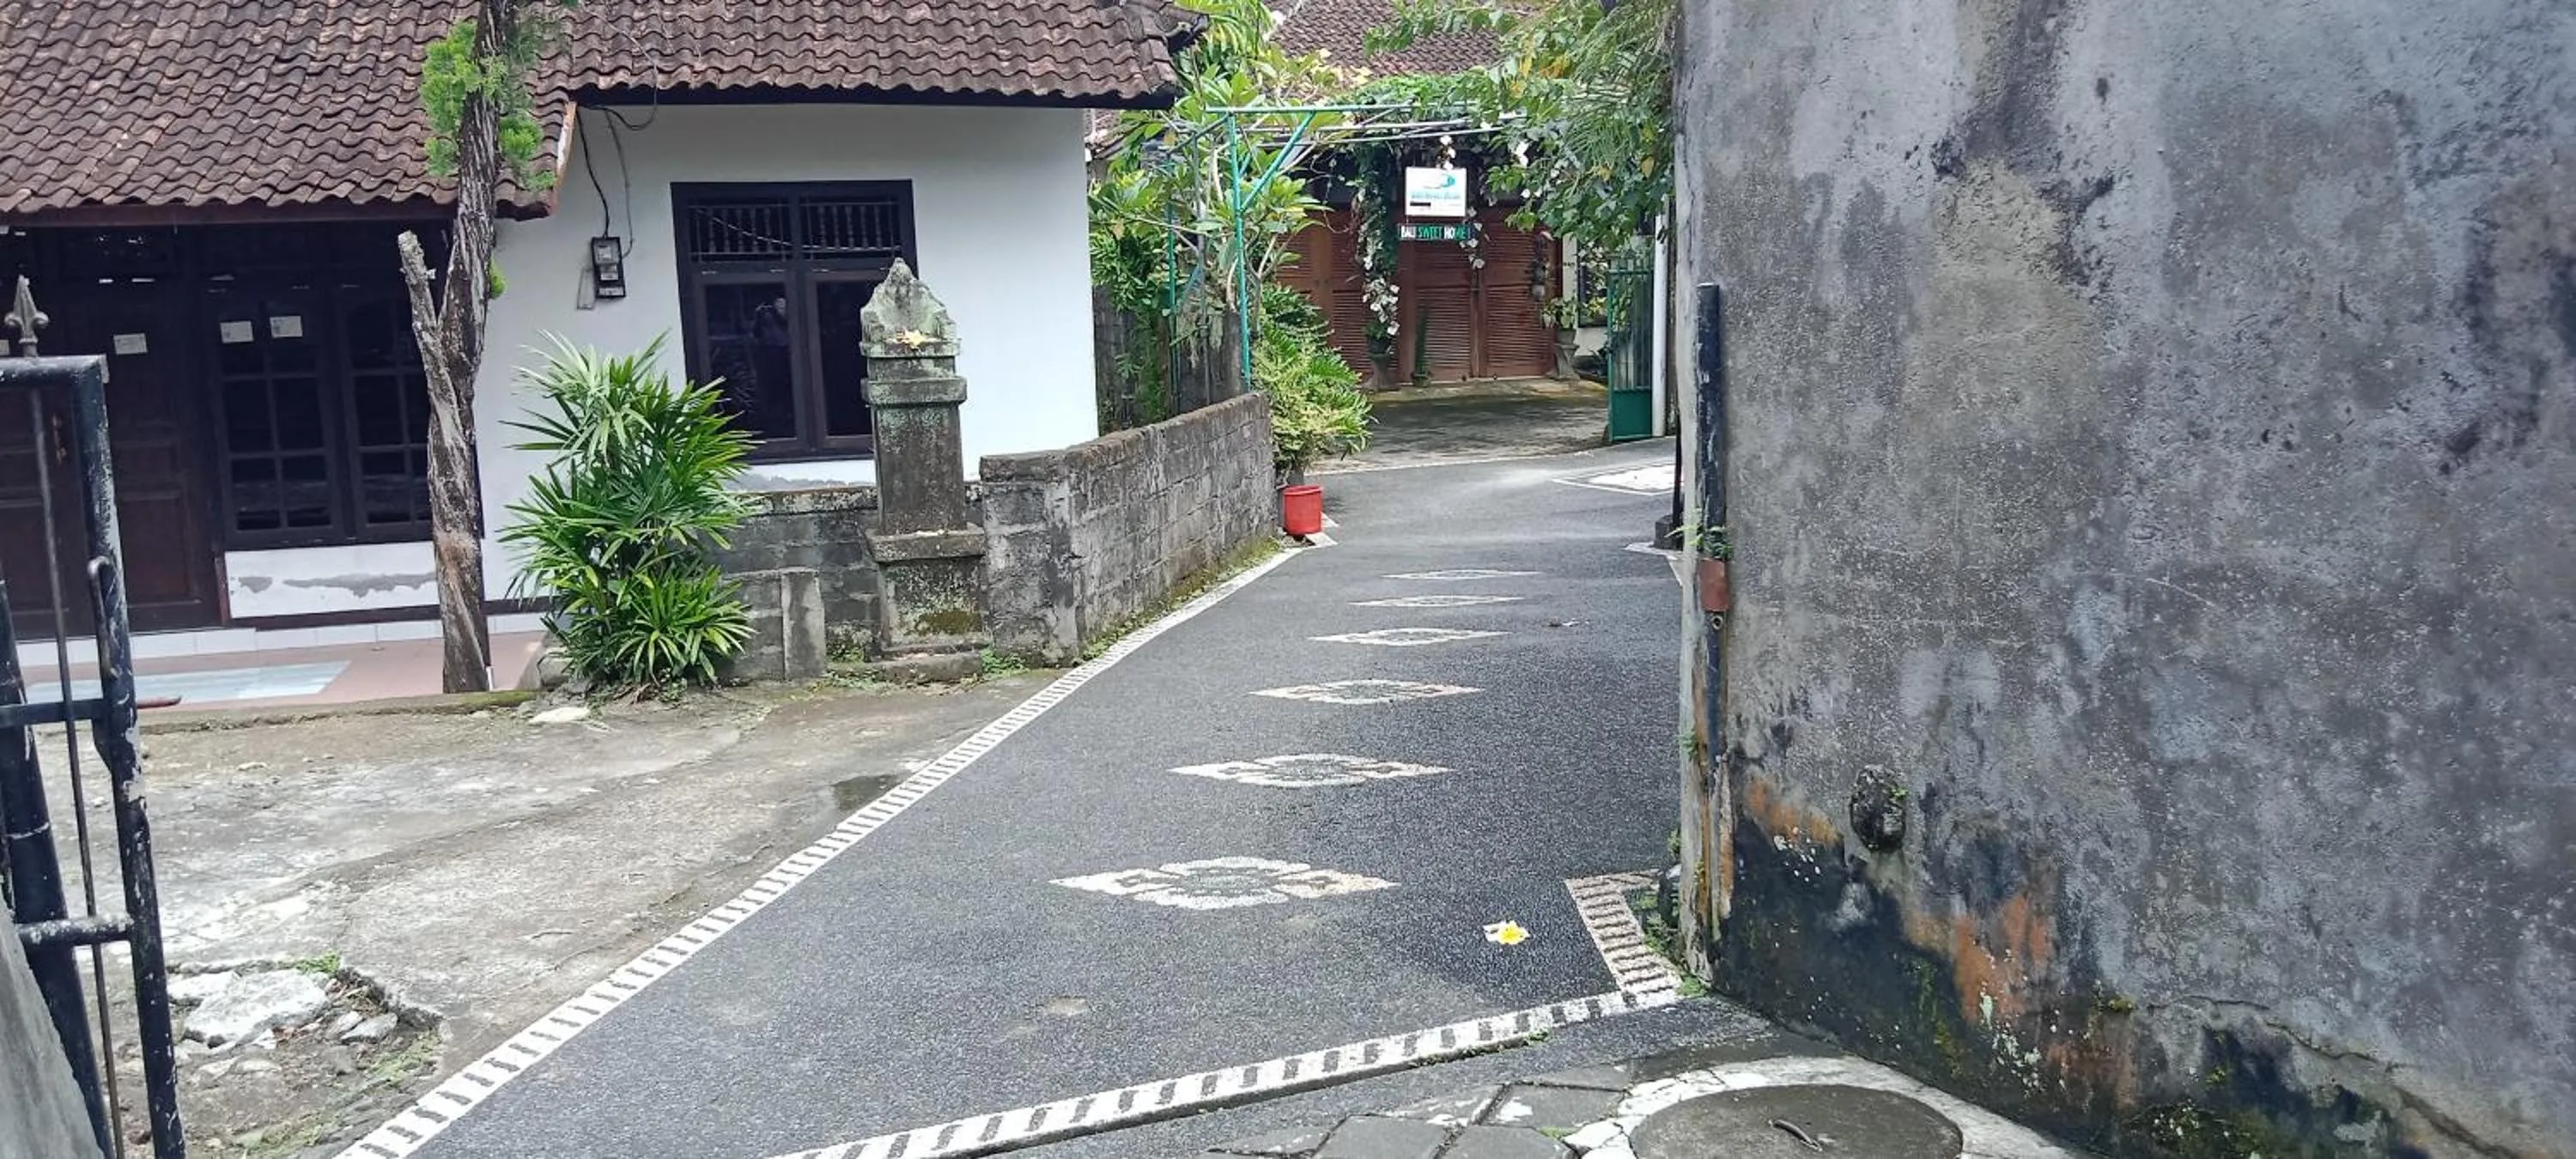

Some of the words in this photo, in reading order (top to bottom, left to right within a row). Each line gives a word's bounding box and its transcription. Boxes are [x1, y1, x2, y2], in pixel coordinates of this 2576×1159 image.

[1401, 226, 1416, 238] BALI
[1418, 226, 1443, 239] SWEET
[1443, 226, 1465, 239] HOME
